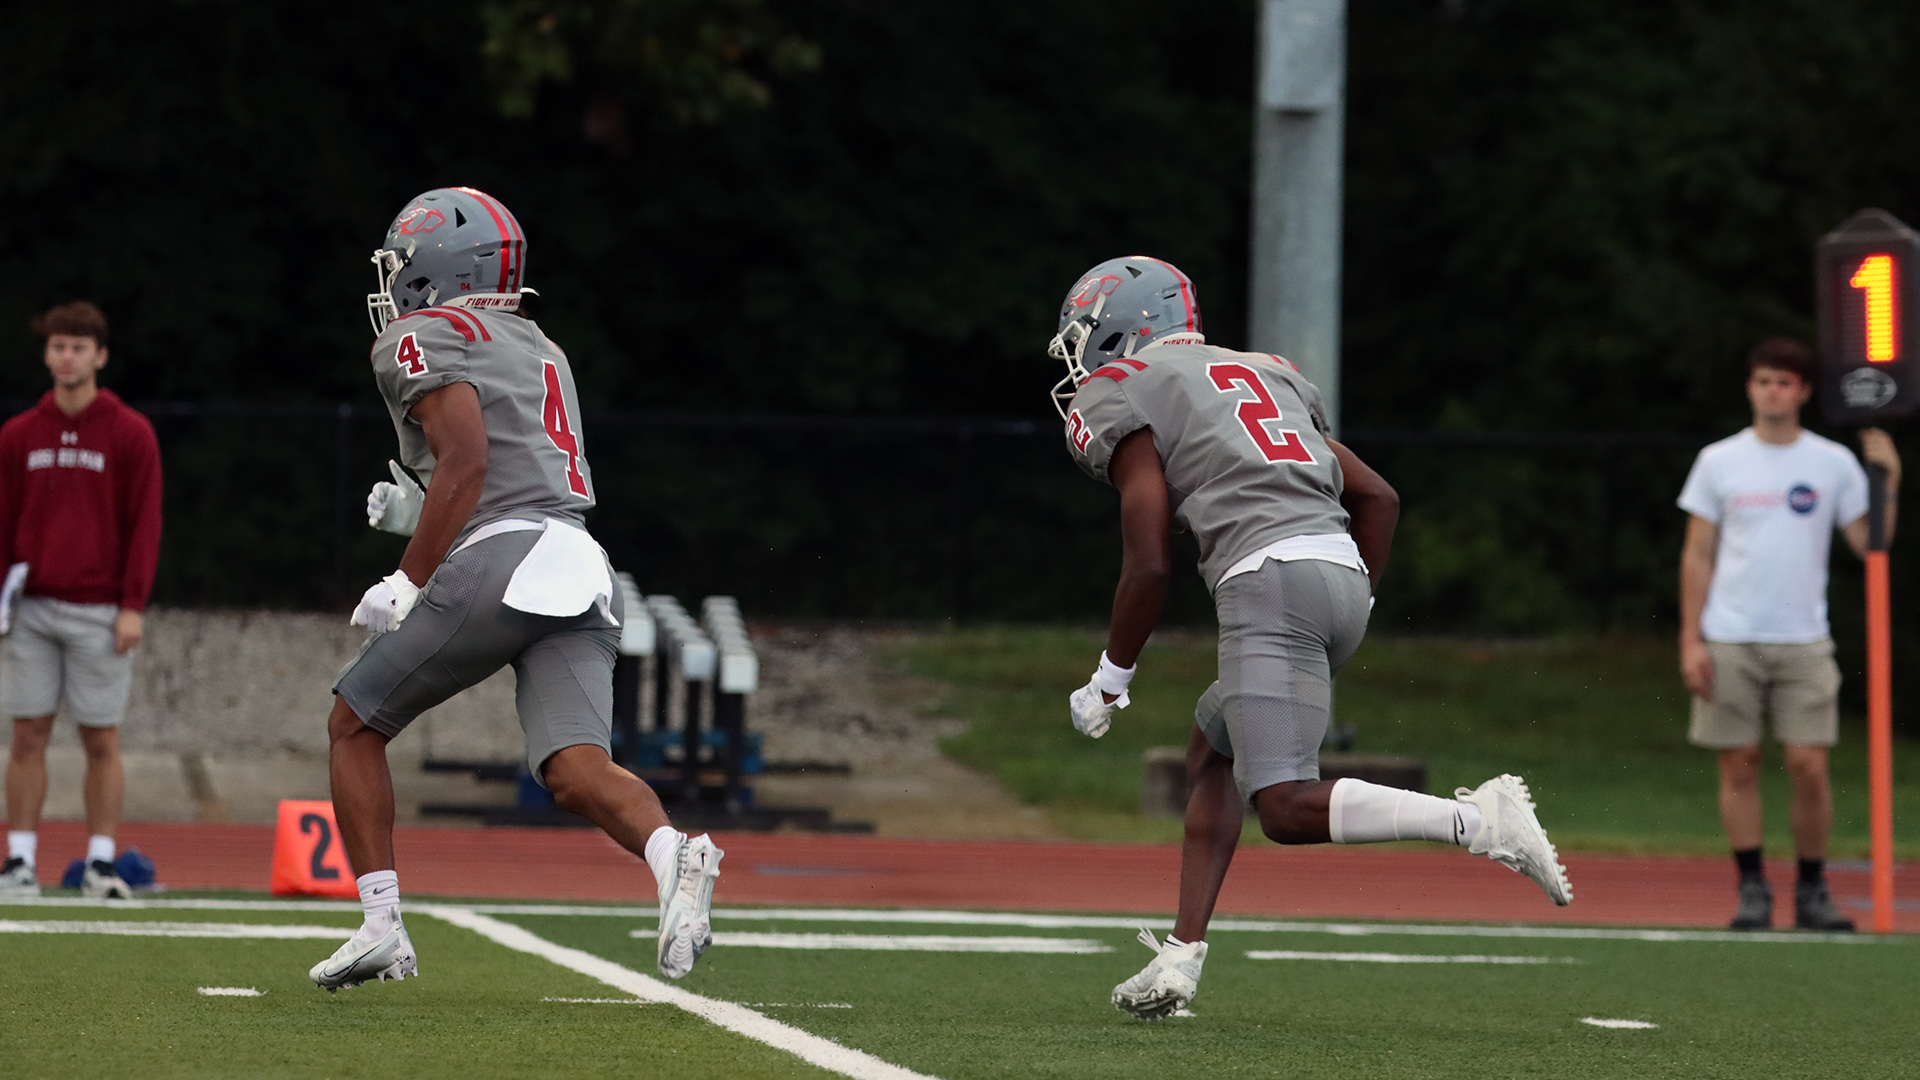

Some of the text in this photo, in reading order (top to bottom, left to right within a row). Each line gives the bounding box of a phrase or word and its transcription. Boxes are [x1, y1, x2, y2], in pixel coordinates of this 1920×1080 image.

[395, 331, 429, 378] 4
[1850, 255, 1895, 362] 1
[540, 358, 590, 501] 4
[1066, 408, 1094, 456] 2
[1206, 362, 1319, 465] 2
